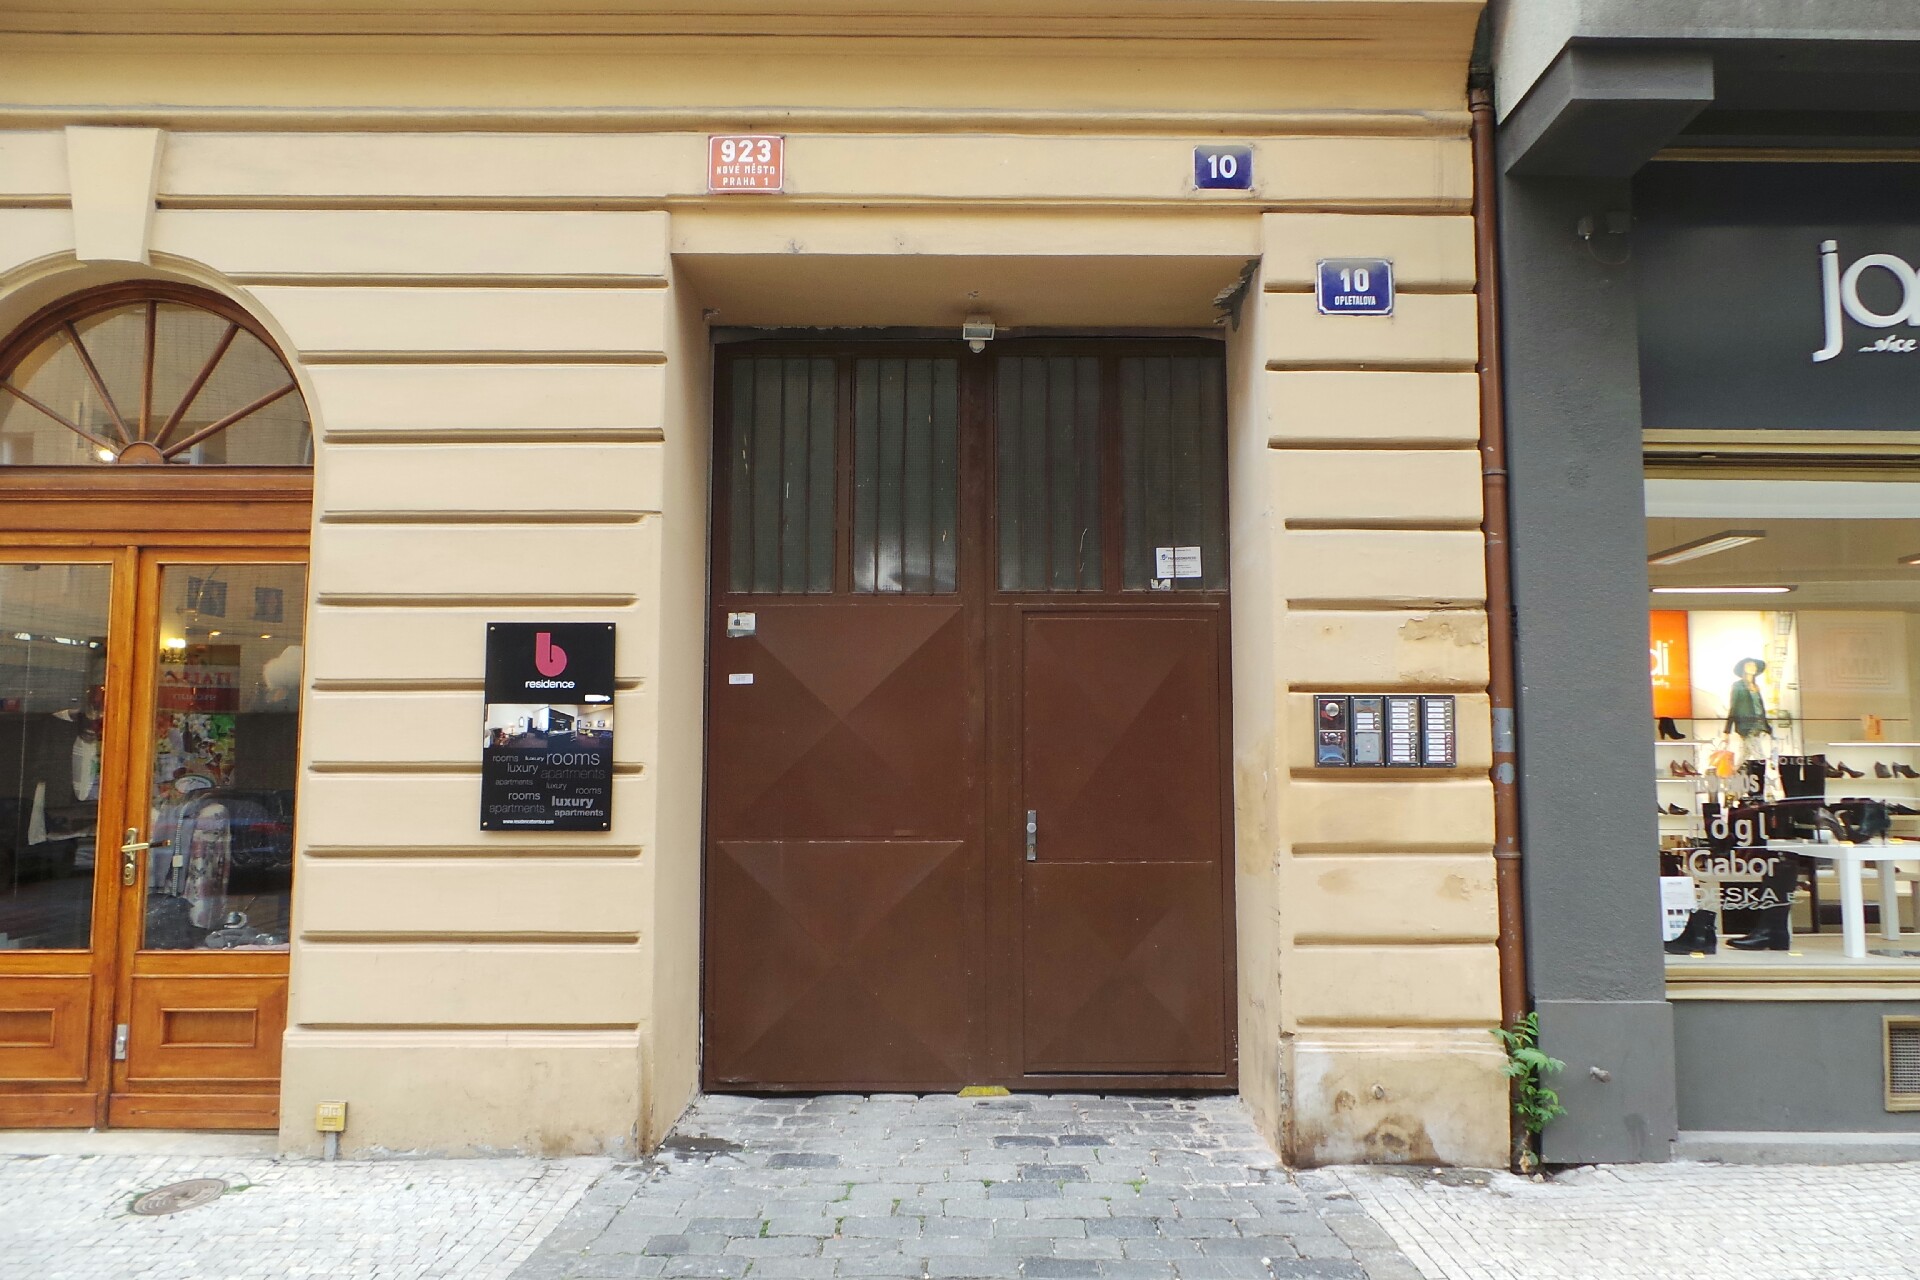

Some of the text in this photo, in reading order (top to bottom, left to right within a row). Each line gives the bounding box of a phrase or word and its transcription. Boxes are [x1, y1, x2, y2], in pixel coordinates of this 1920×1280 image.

[721, 140, 771, 162] 923
[717, 163, 740, 174] NOVÉ
[1207, 154, 1237, 178] 10
[722, 177, 769, 186] PRAHA 1
[1340, 268, 1370, 292] 10
[1334, 296, 1376, 306] OPLETALOVA
[535, 632, 567, 677] b
[525, 680, 576, 689] residence
[546, 752, 600, 766] rooms
[507, 763, 539, 774] luxury
[541, 769, 606, 780] apartments
[546, 782, 568, 791] luxury
[575, 787, 602, 795] rooms
[508, 792, 541, 800] rooms
[551, 796, 594, 809] luxury
[489, 803, 545, 815] apartments
[554, 809, 604, 818] apartments
[1689, 849, 1780, 877] Gabor
